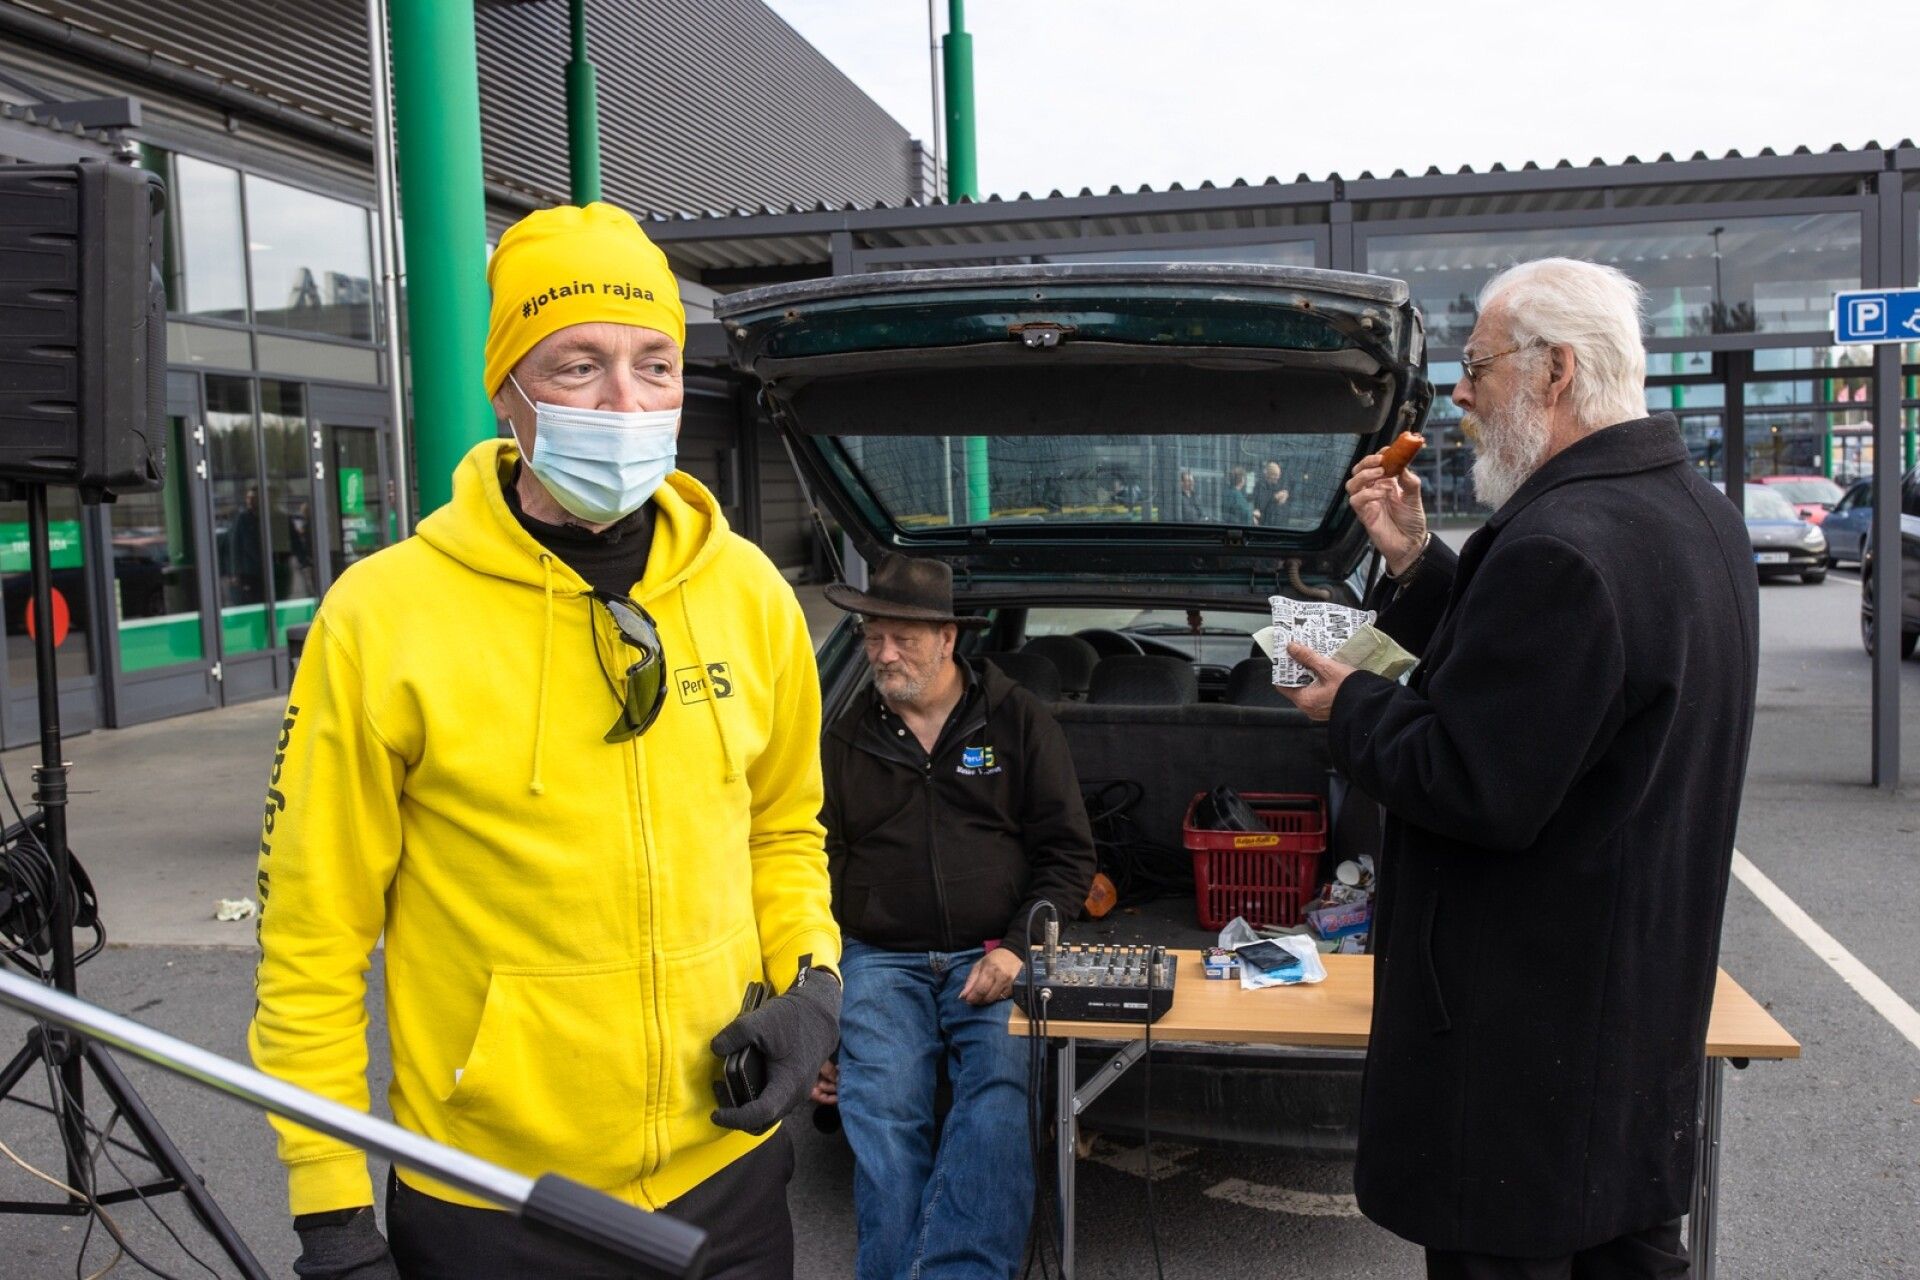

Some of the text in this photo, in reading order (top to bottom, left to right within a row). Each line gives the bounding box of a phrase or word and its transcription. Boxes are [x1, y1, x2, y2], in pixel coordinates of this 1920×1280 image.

[522, 281, 655, 319] #jotain rajaa
[1857, 303, 1880, 331] P
